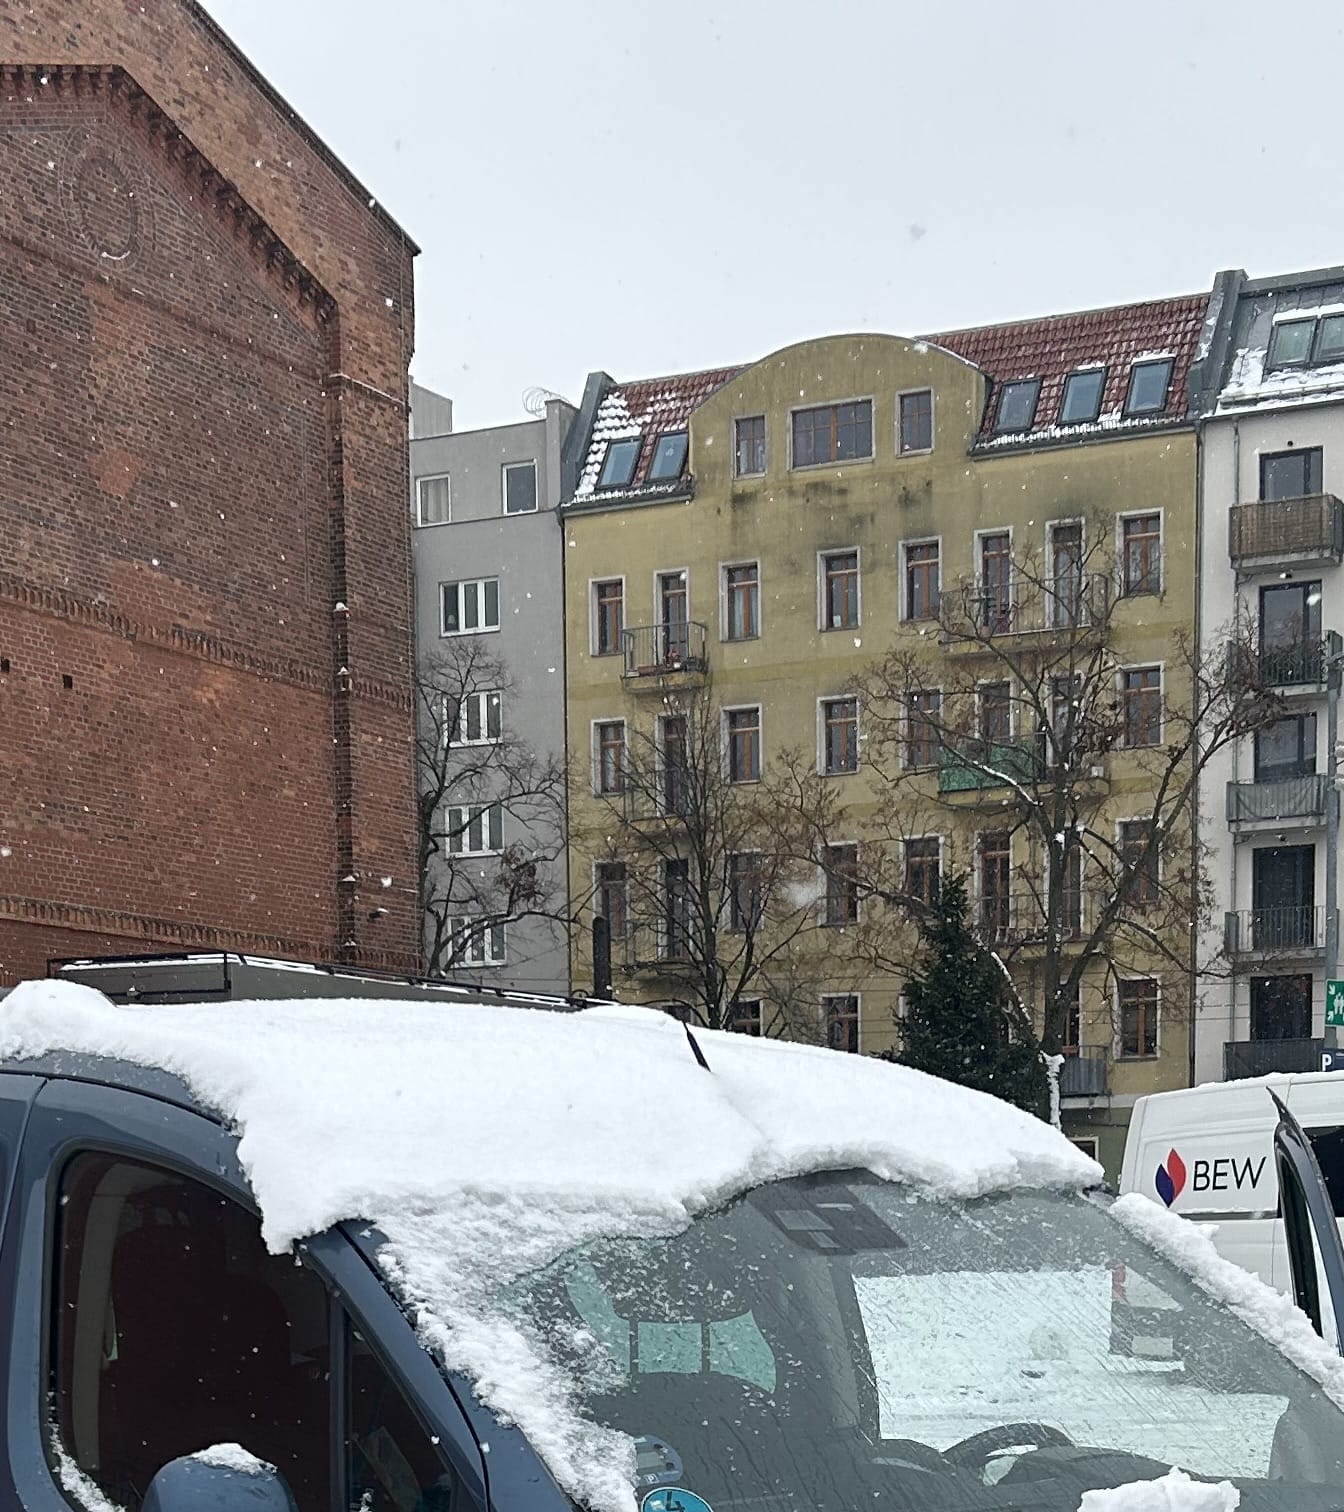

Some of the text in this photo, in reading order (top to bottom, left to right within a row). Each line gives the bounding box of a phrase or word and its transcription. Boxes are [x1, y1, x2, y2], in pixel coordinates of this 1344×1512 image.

[1321, 1054, 1332, 1071] P
[1193, 1156, 1267, 1191] BEW
[666, 1490, 686, 1512] 4
